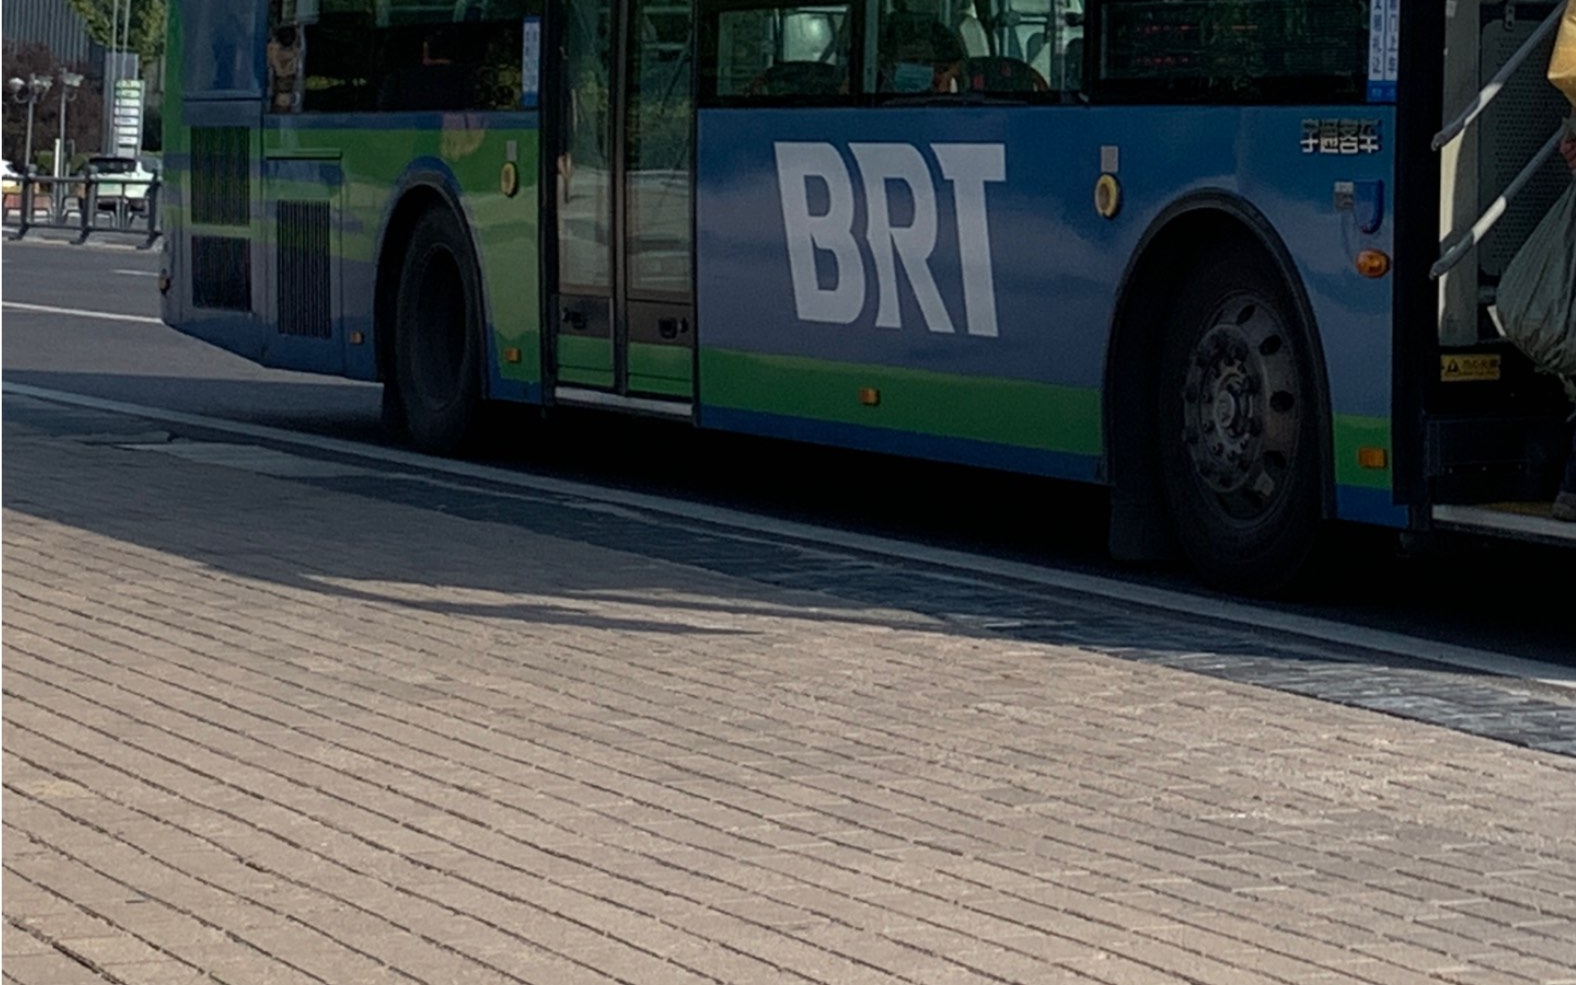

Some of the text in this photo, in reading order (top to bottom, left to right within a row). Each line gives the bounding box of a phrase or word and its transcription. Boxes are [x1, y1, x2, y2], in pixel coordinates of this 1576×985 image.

[1300, 118, 1380, 154] 宇通客车
[774, 141, 1006, 338] BRT
